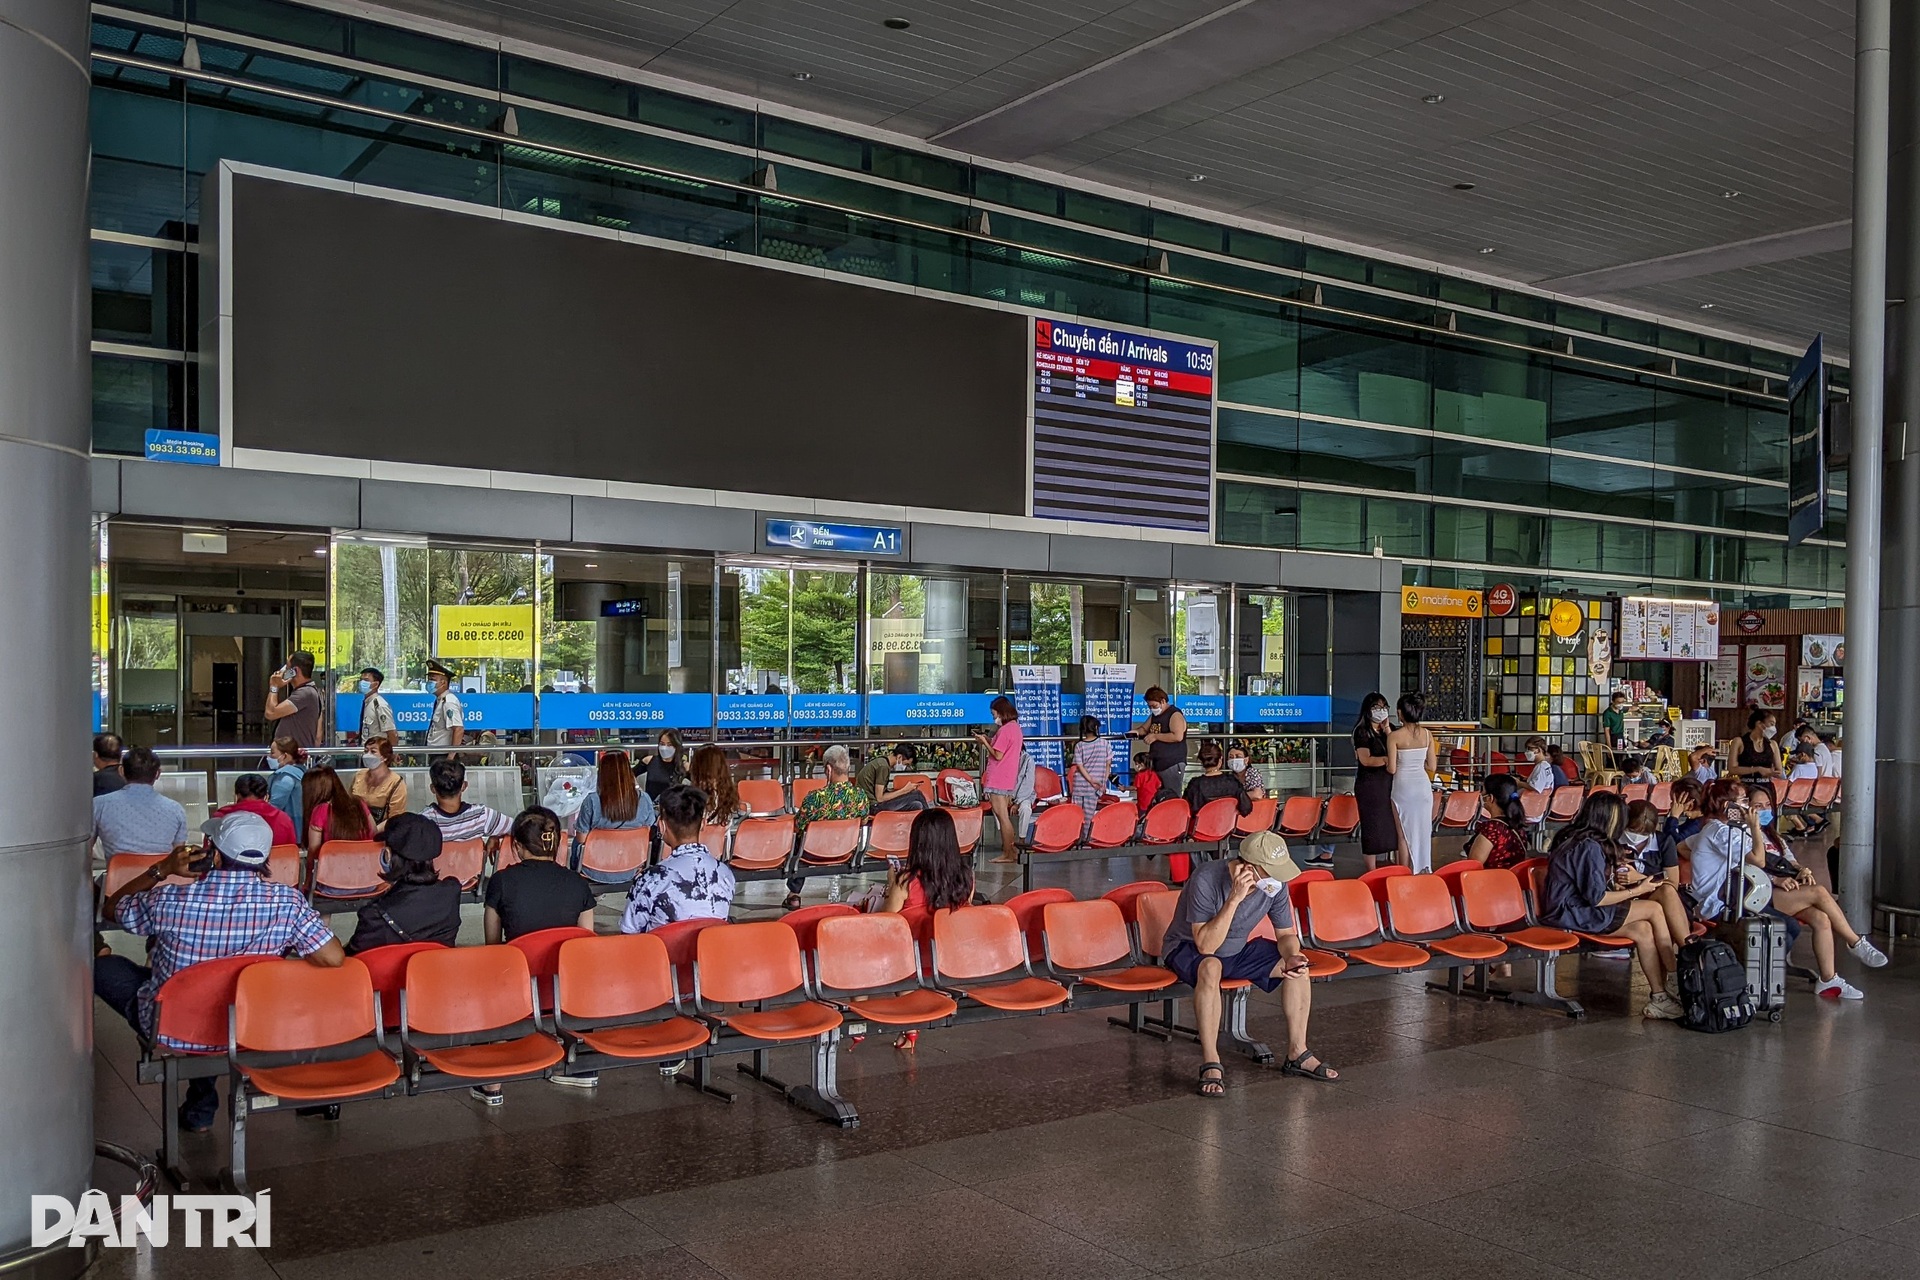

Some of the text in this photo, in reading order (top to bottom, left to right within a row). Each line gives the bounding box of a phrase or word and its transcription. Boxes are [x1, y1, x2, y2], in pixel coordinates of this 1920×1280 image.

[1053, 328, 1096, 353] Chuyến
[1098, 333, 1119, 356] đến
[1127, 341, 1168, 363] Arrivals
[1186, 351, 1213, 371] 10:59
[1036, 361, 1056, 369] SCHEDULED
[1056, 364, 1074, 372] ESTIMATED
[183, 440, 204, 448] Booking
[150, 443, 216, 456] 0933.33.99.88
[813, 525, 895, 550] ĐẾN A1
[813, 538, 833, 546] Arrival
[1494, 589, 1508, 600] 4G
[1422, 594, 1463, 606] mobifone
[589, 710, 664, 720] 0933.33.99.88
[717, 710, 785, 720] 0933.33.99.88
[793, 710, 857, 719] 0933.33.99.88
[906, 708, 964, 718] 0933.33.99.88
[1260, 708, 1302, 716] 0933.33.99.88
